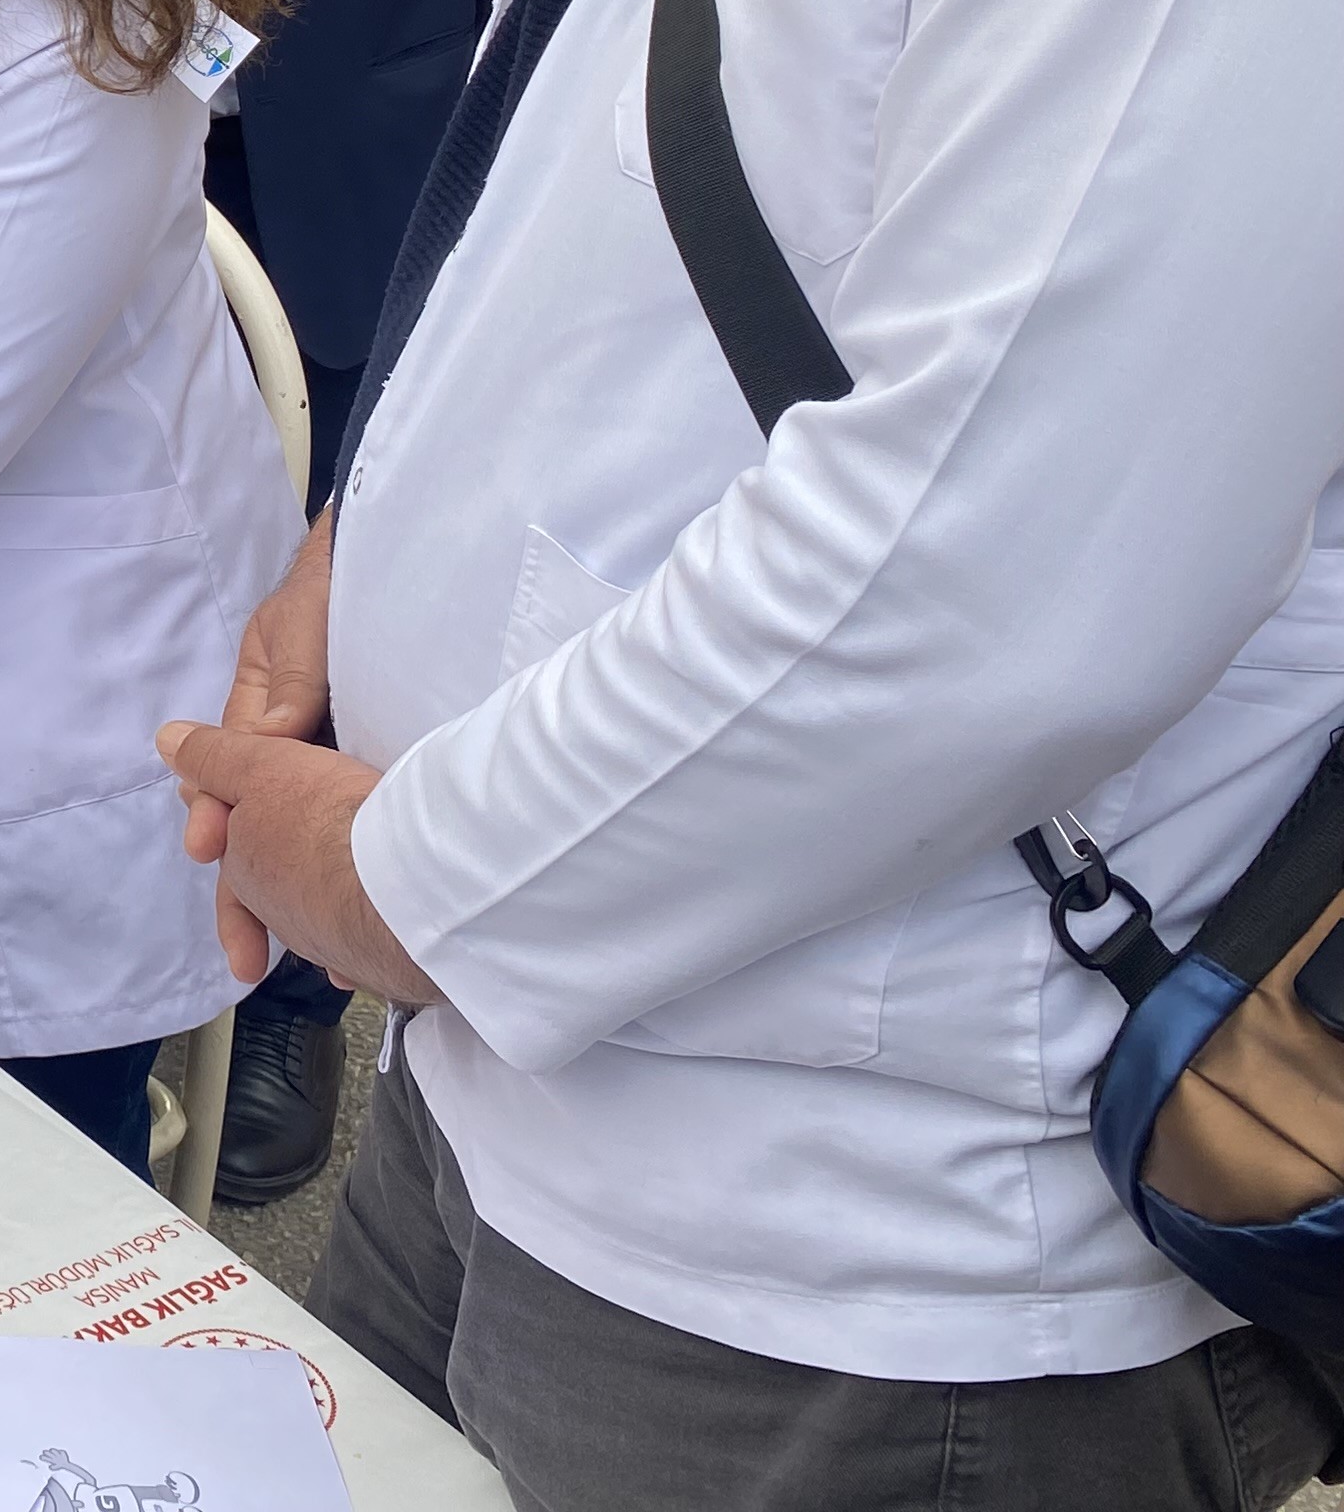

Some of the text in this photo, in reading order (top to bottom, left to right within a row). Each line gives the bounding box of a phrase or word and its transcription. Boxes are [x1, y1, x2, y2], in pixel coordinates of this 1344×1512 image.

[105, 1224, 180, 1264] SAĞLIK
[73, 1264, 248, 1343] SAĞLIK BAK
